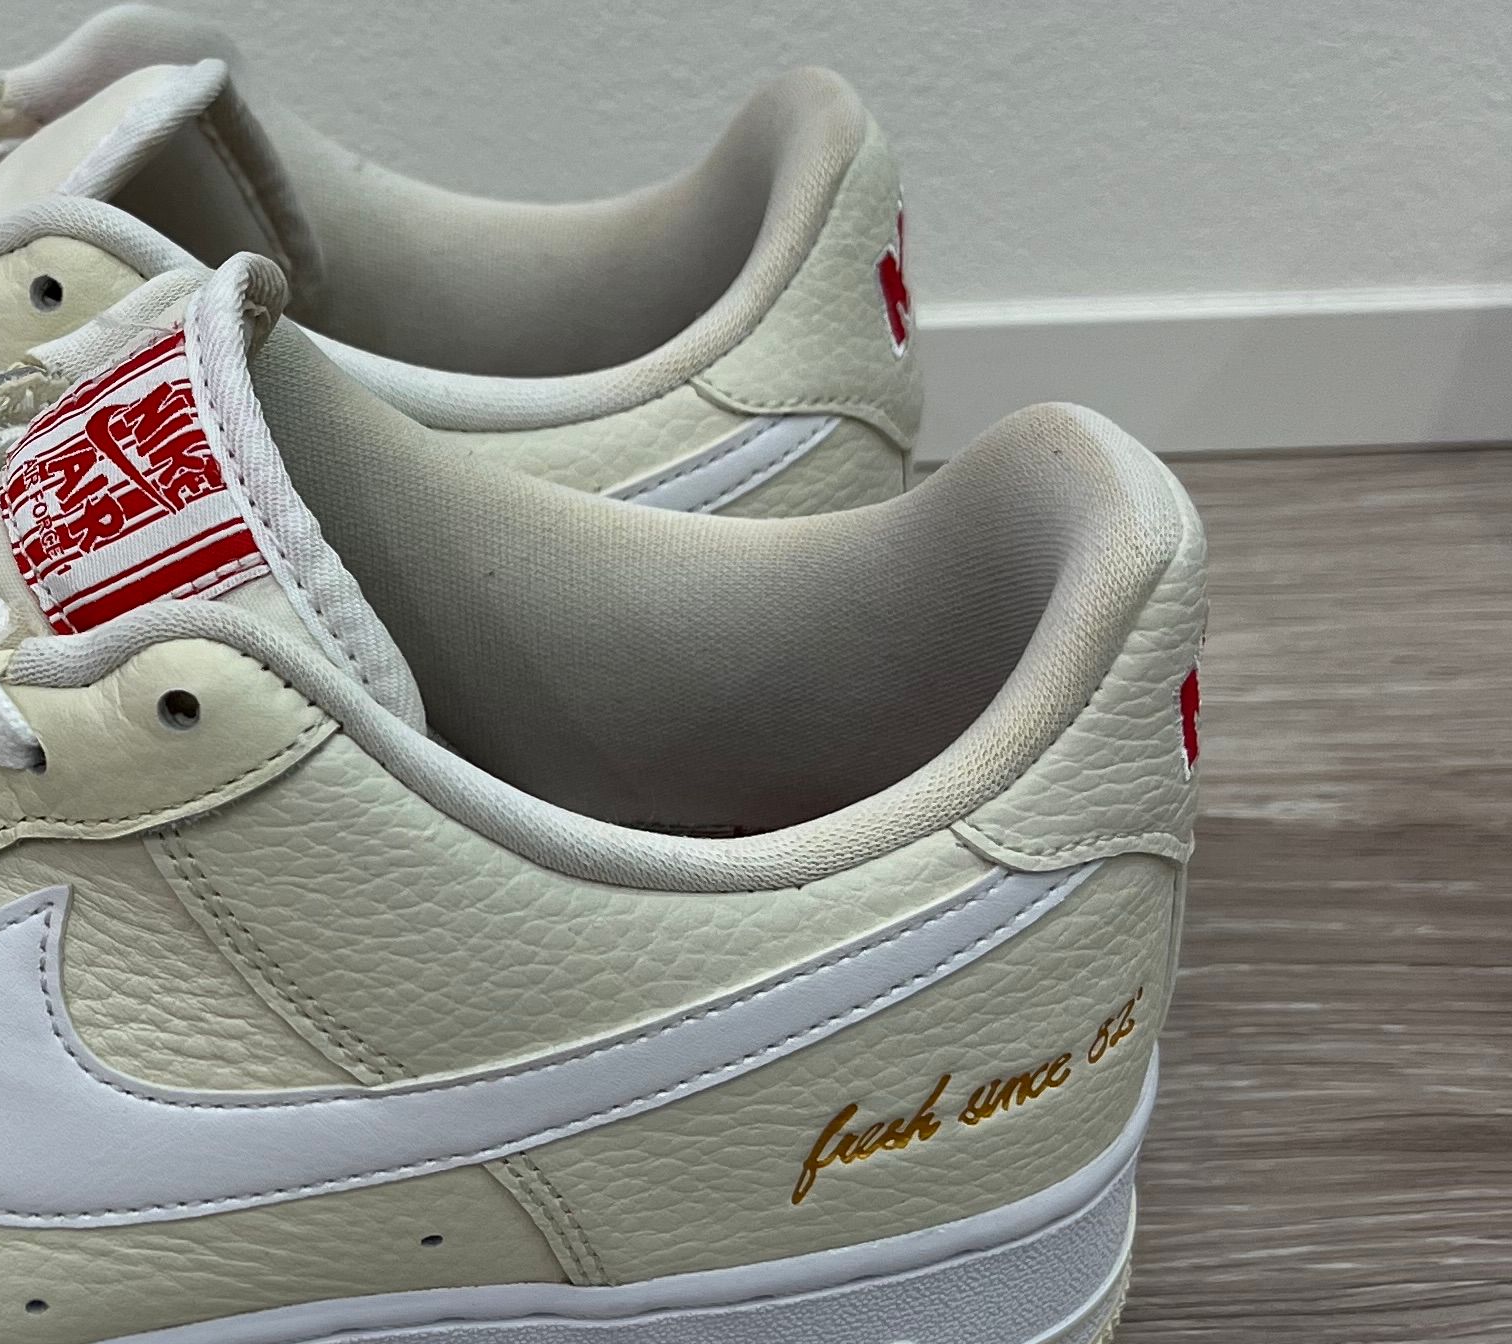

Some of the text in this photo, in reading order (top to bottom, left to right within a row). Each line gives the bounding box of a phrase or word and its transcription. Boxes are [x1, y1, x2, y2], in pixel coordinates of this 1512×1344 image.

[45, 446, 125, 554] AIR
[121, 381, 223, 512] NIKE
[22, 458, 72, 576] AIR FORCE 1
[792, 1074, 951, 1205] fresh
[958, 1052, 1072, 1125] since
